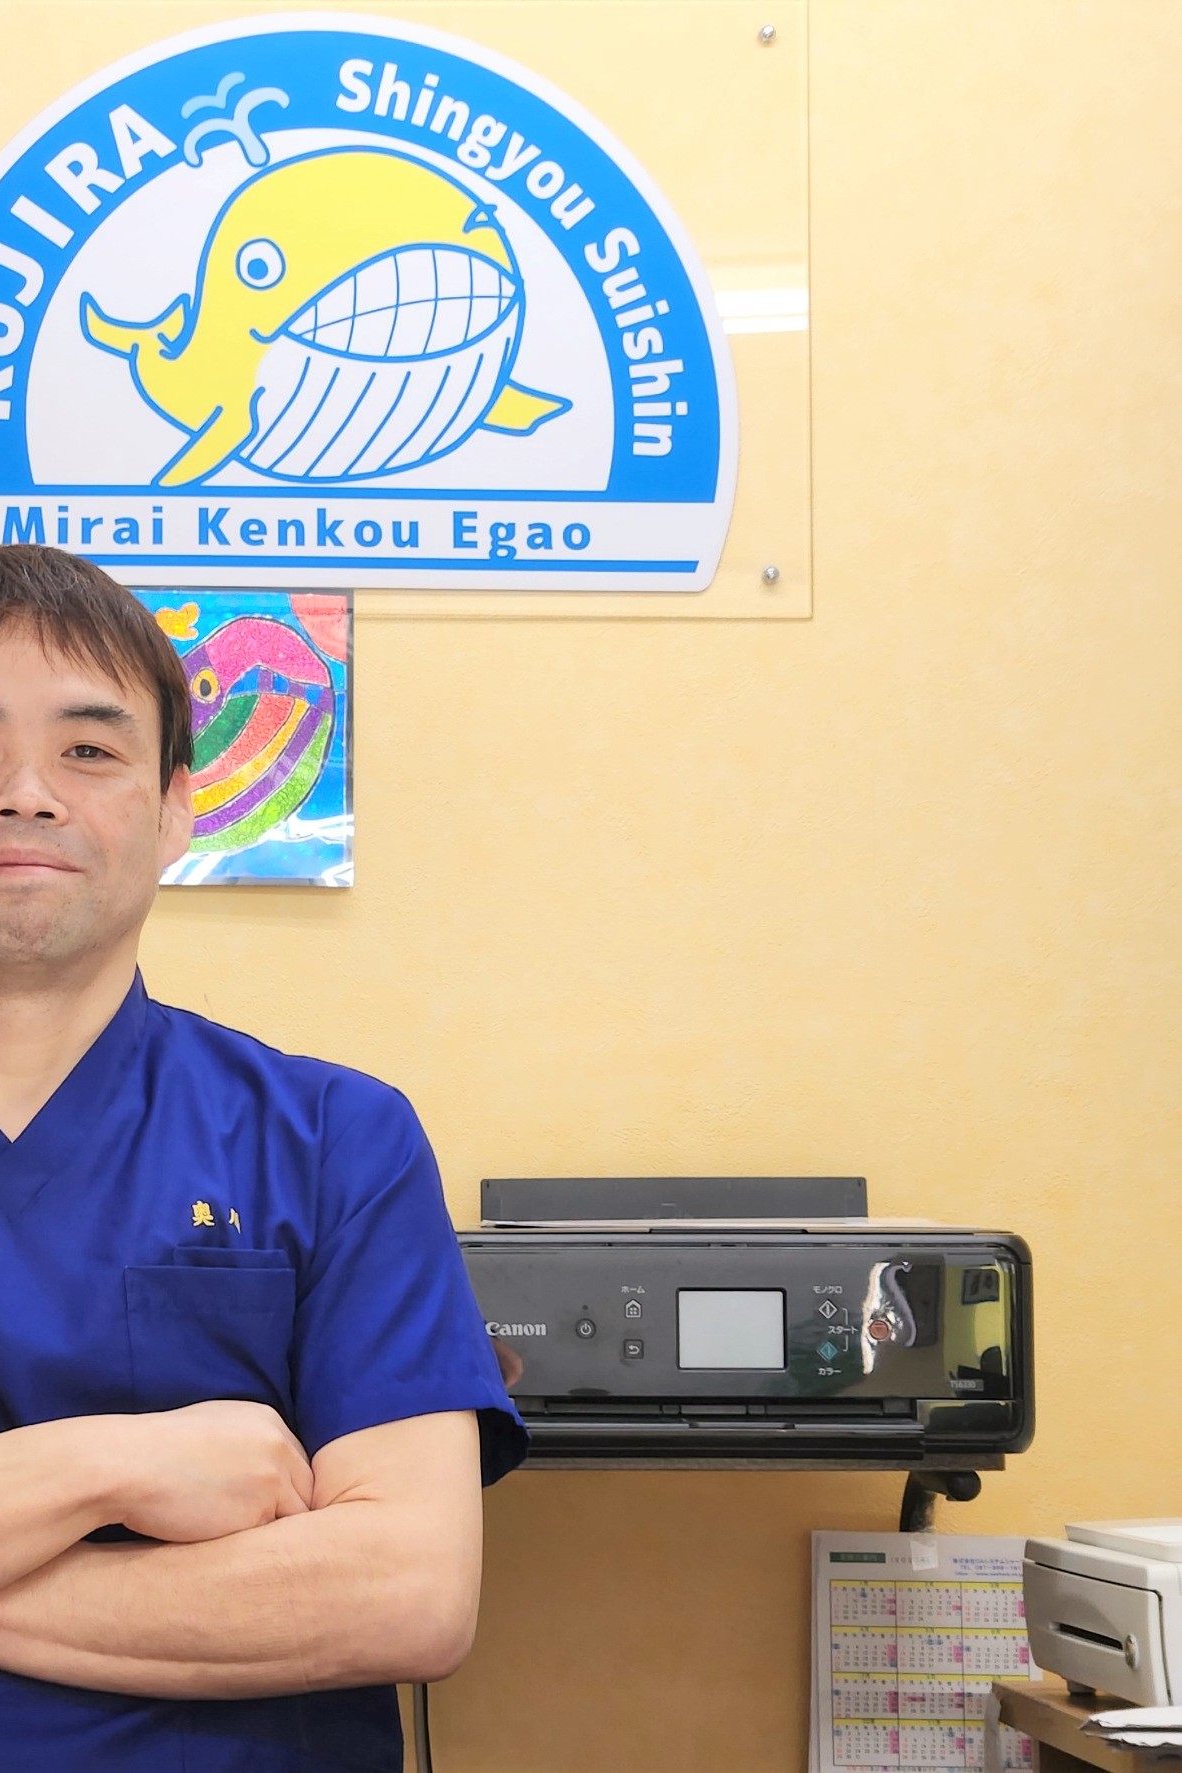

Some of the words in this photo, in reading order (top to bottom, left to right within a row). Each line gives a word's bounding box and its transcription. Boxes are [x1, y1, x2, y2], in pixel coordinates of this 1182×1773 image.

[335, 58, 596, 230] Shingyou
[584, 227, 688, 456] Suishin
[2, 504, 164, 546] Mirai
[197, 506, 420, 549] Kenkou
[452, 510, 591, 560] Egao
[621, 1286, 646, 1294] ホーム
[813, 1285, 843, 1294] モノクロ
[485, 1321, 547, 1337] Canon
[828, 1326, 858, 1334] スタート
[818, 1367, 842, 1376] カラー
